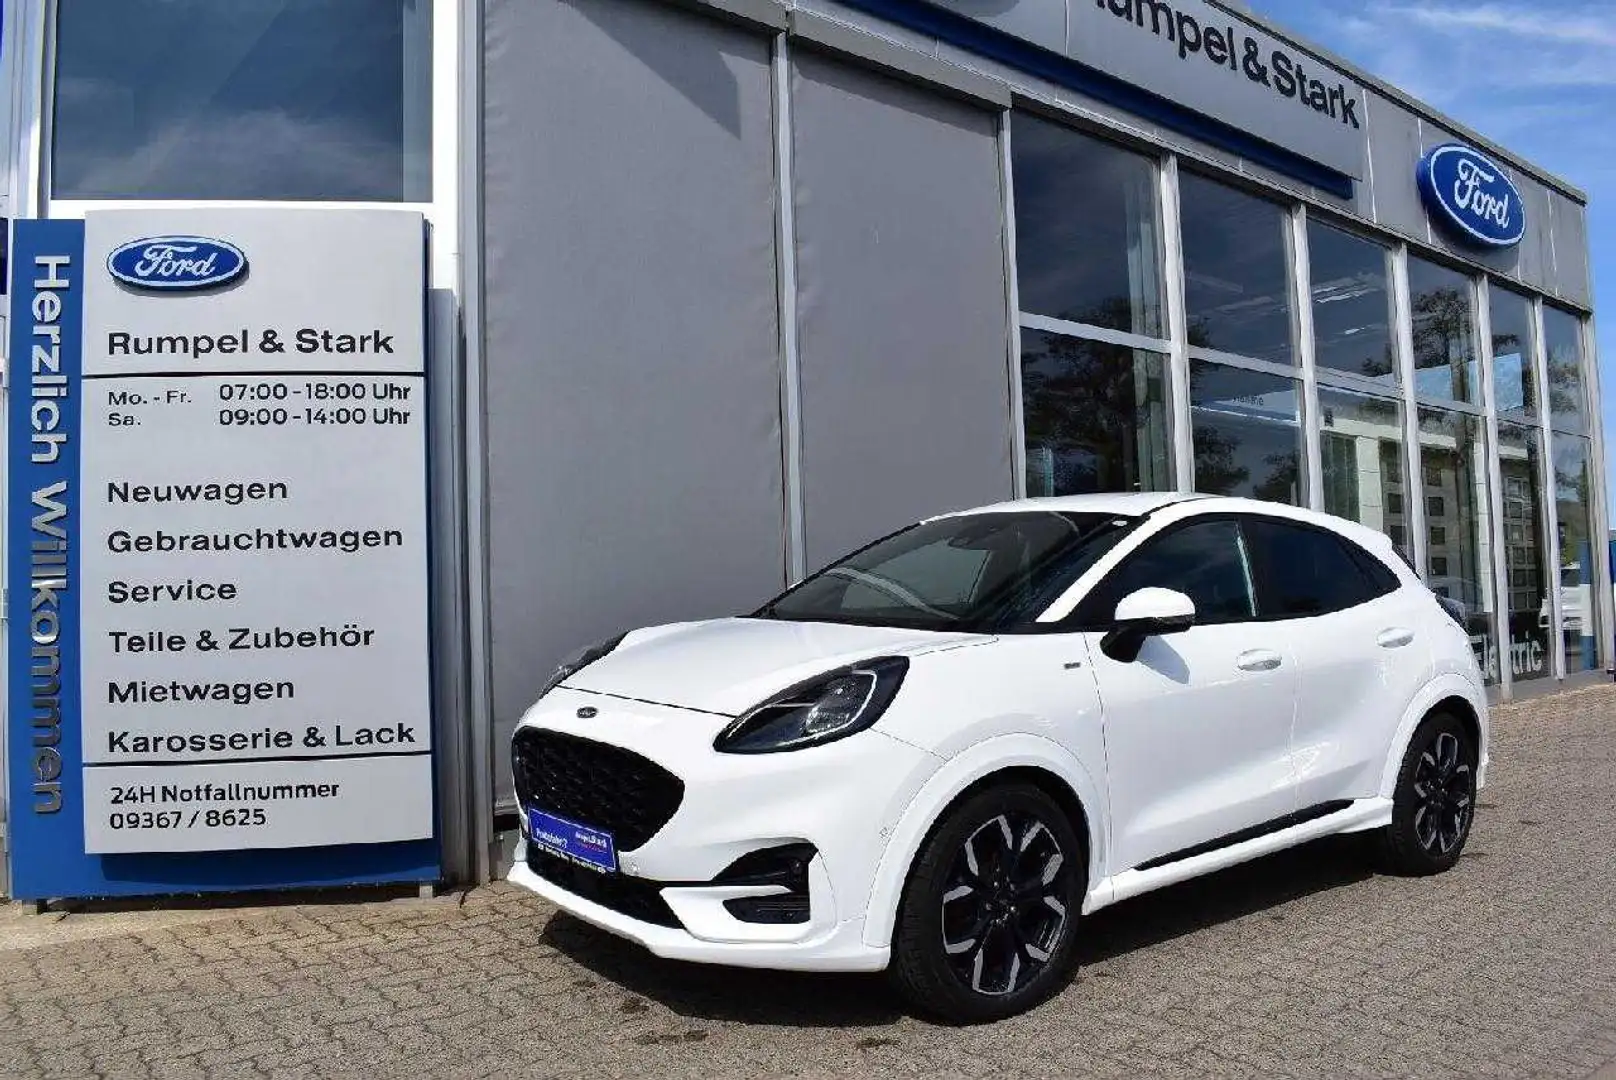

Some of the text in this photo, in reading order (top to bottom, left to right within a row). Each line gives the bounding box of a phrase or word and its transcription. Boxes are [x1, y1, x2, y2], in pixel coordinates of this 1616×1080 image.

[1097, 0, 1360, 129] umpel & Stark
[1454, 158, 1510, 229] Ford
[134, 244, 218, 277] Ford
[108, 328, 395, 359] Rumpel & Stark
[108, 391, 148, 406] Mo.
[166, 390, 192, 404] Fr.
[372, 382, 412, 400] Uhr
[108, 412, 141, 427] Sa.
[372, 406, 412, 425] Uhr
[108, 481, 288, 505] Neuwagen
[30, 255, 71, 814] Herzlich Willkommen
[107, 528, 403, 554] Gebrauchtwagen
[108, 579, 238, 604] Service
[108, 624, 376, 653] Teile & Zubehör
[108, 680, 295, 705] Mietwagen
[108, 722, 416, 753] Karosserie & Lack
[110, 782, 340, 805] 24H Notfallnummer
[109, 810, 183, 830] 09367
[205, 808, 267, 828] 8625
